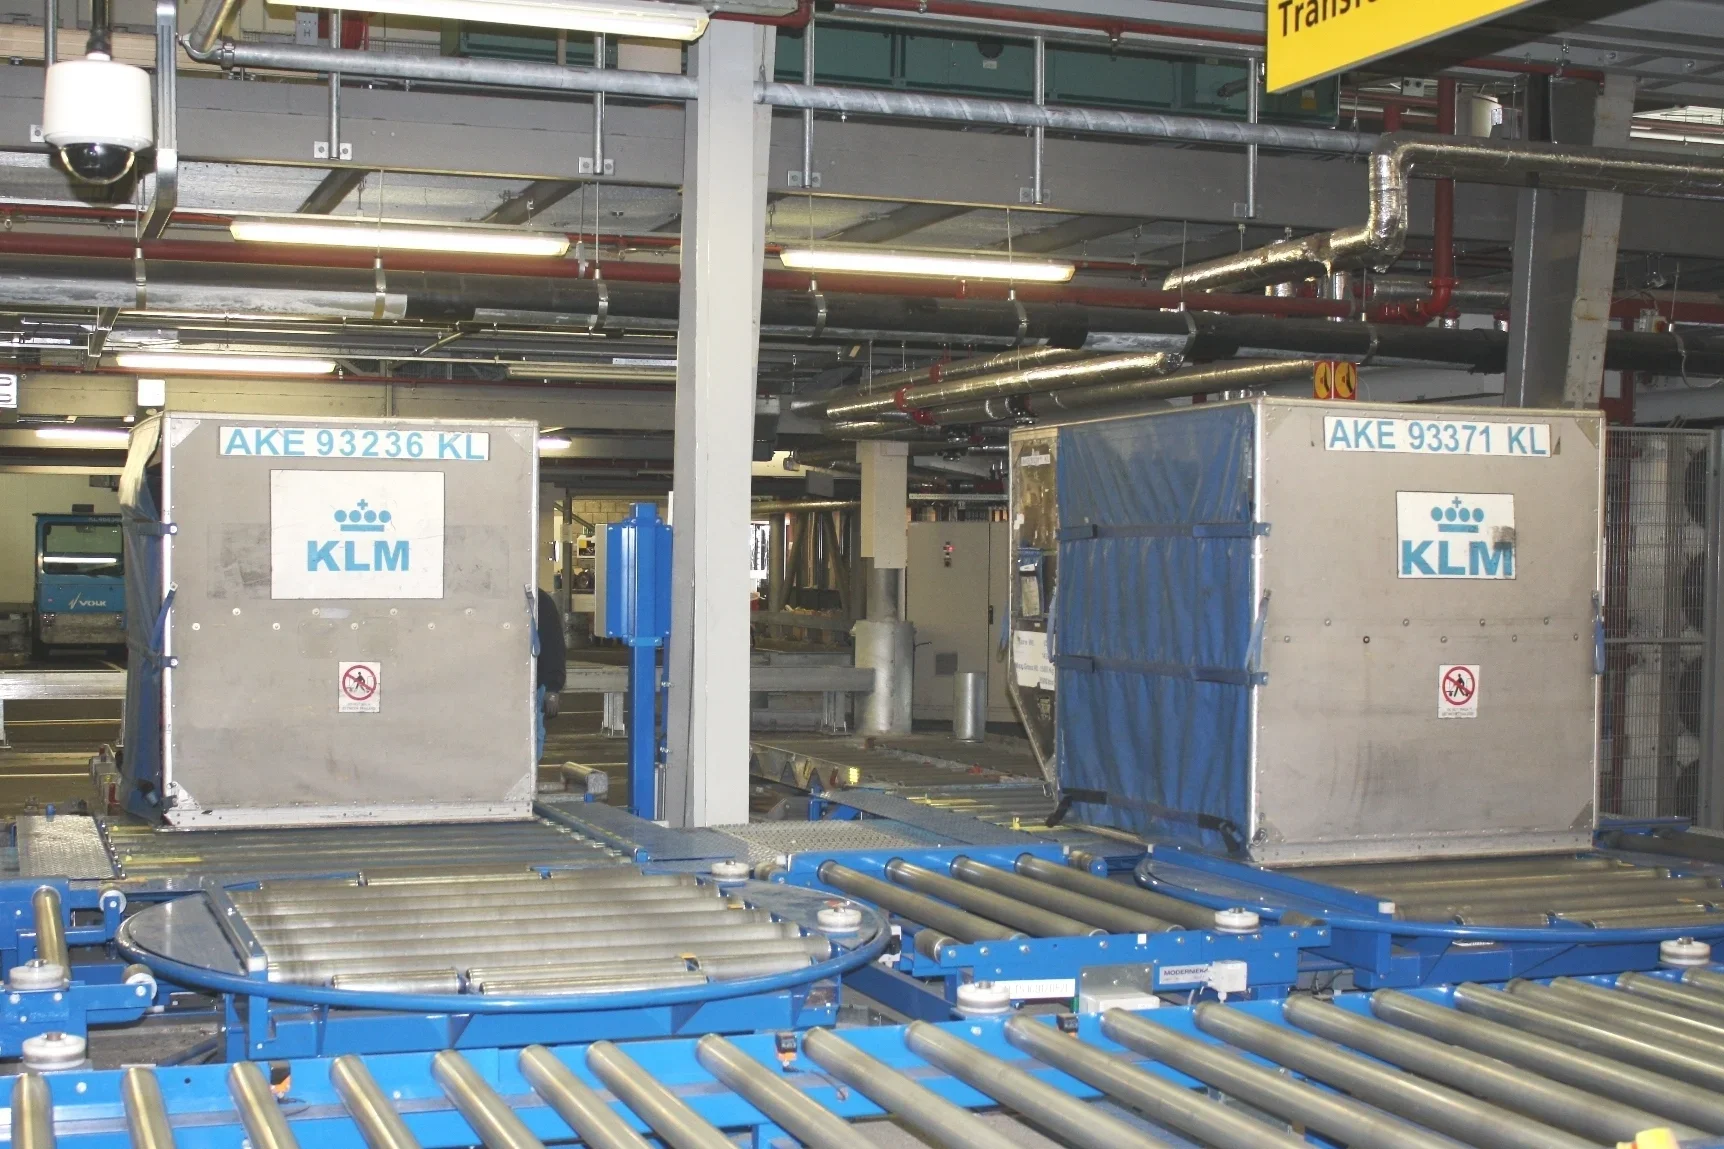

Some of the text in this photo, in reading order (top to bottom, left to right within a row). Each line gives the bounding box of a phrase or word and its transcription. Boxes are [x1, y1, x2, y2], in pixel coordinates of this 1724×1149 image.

[1278, 0, 1377, 37] Trans
[224, 428, 485, 460] AKE 93236 KL
[1329, 419, 1547, 455] AKE 93371 KL
[307, 540, 410, 572] KLM
[1402, 540, 1512, 576] KLM
[79, 600, 107, 608] VOLK
